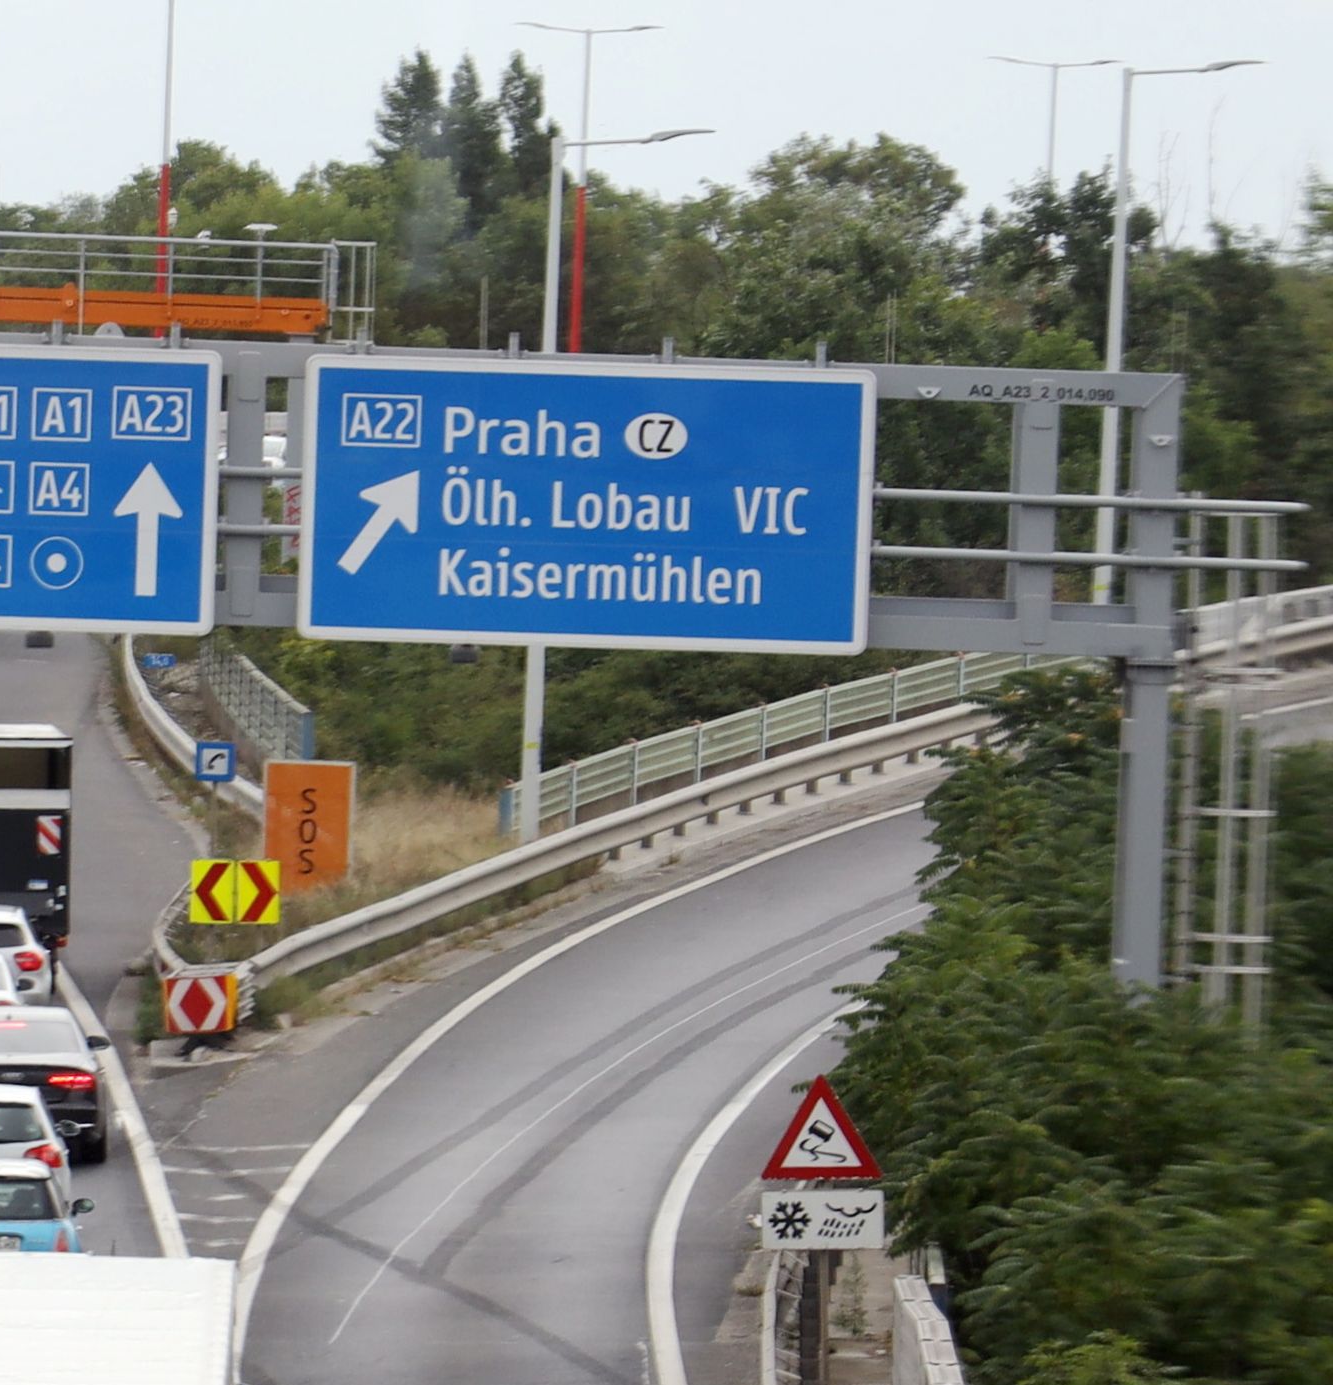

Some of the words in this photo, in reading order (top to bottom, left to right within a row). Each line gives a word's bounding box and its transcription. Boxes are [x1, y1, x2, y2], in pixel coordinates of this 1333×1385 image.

[41, 394, 84, 435] A1
[119, 394, 184, 435] A23
[348, 401, 415, 442] A22
[443, 406, 602, 459] Praha
[638, 419, 674, 453] CZ
[36, 469, 82, 509] A4
[441, 466, 533, 528] Ölh.
[552, 480, 691, 533] Lobau
[734, 486, 810, 536] VIC
[438, 547, 762, 605] Kaisermühlen
[297, 787, 318, 875] SOS
